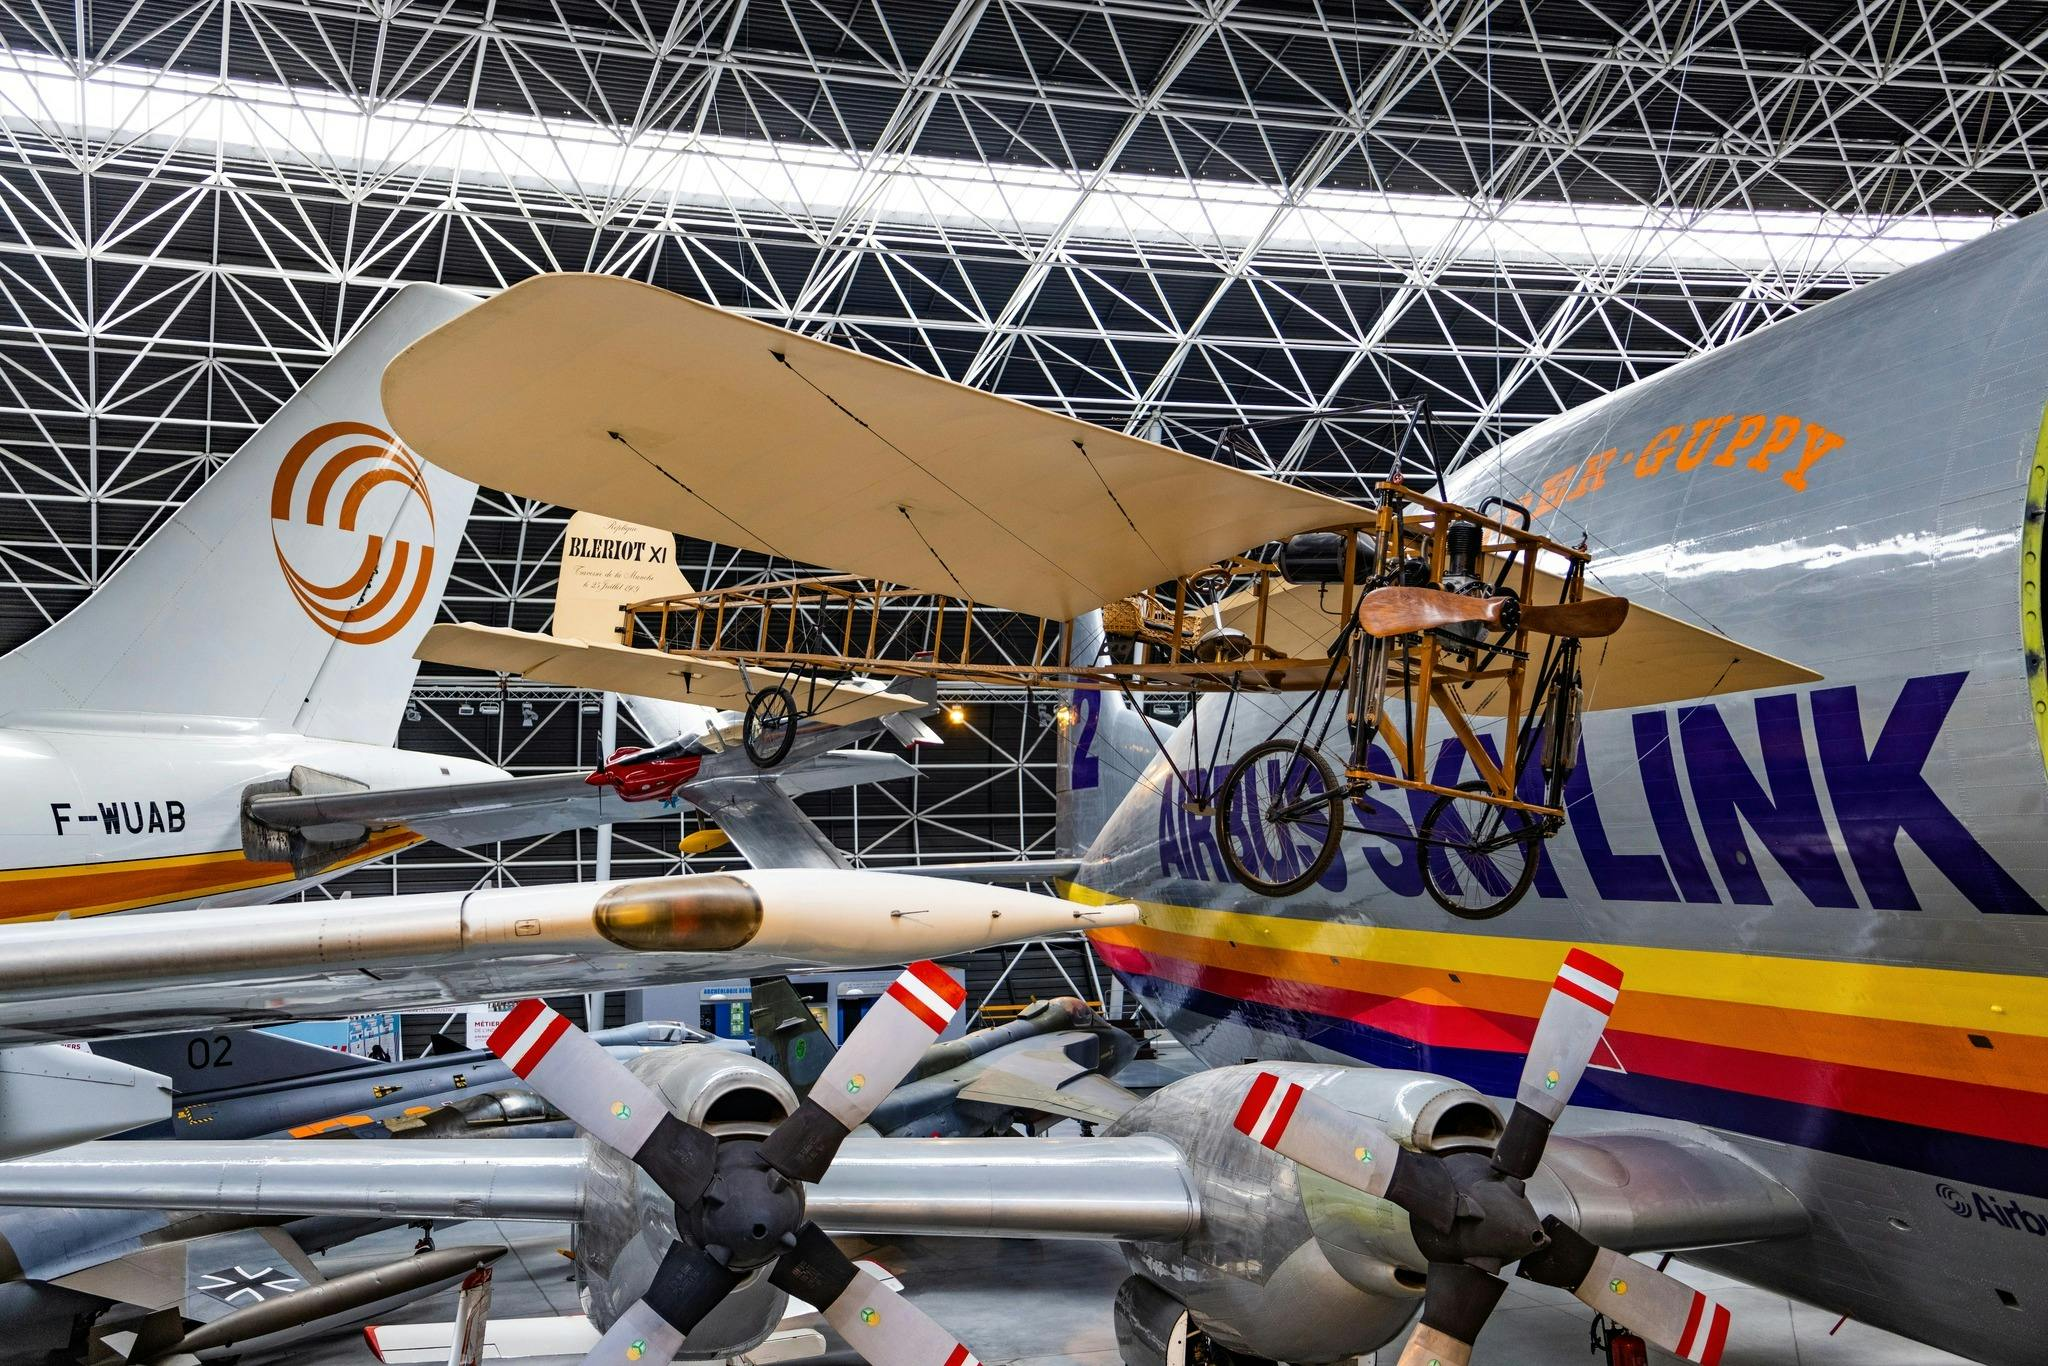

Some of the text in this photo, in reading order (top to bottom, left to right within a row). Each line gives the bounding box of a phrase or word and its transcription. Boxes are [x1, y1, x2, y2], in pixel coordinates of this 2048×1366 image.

[1634, 415, 1846, 493] GUPPY
[568, 537, 667, 564] BLERIOT XI
[1159, 671, 2048, 916] AIRBUS SKYLINK
[50, 800, 186, 836] F-WUAB
[474, 1020, 500, 1028] MÉTIER
[187, 1035, 233, 1070] 02
